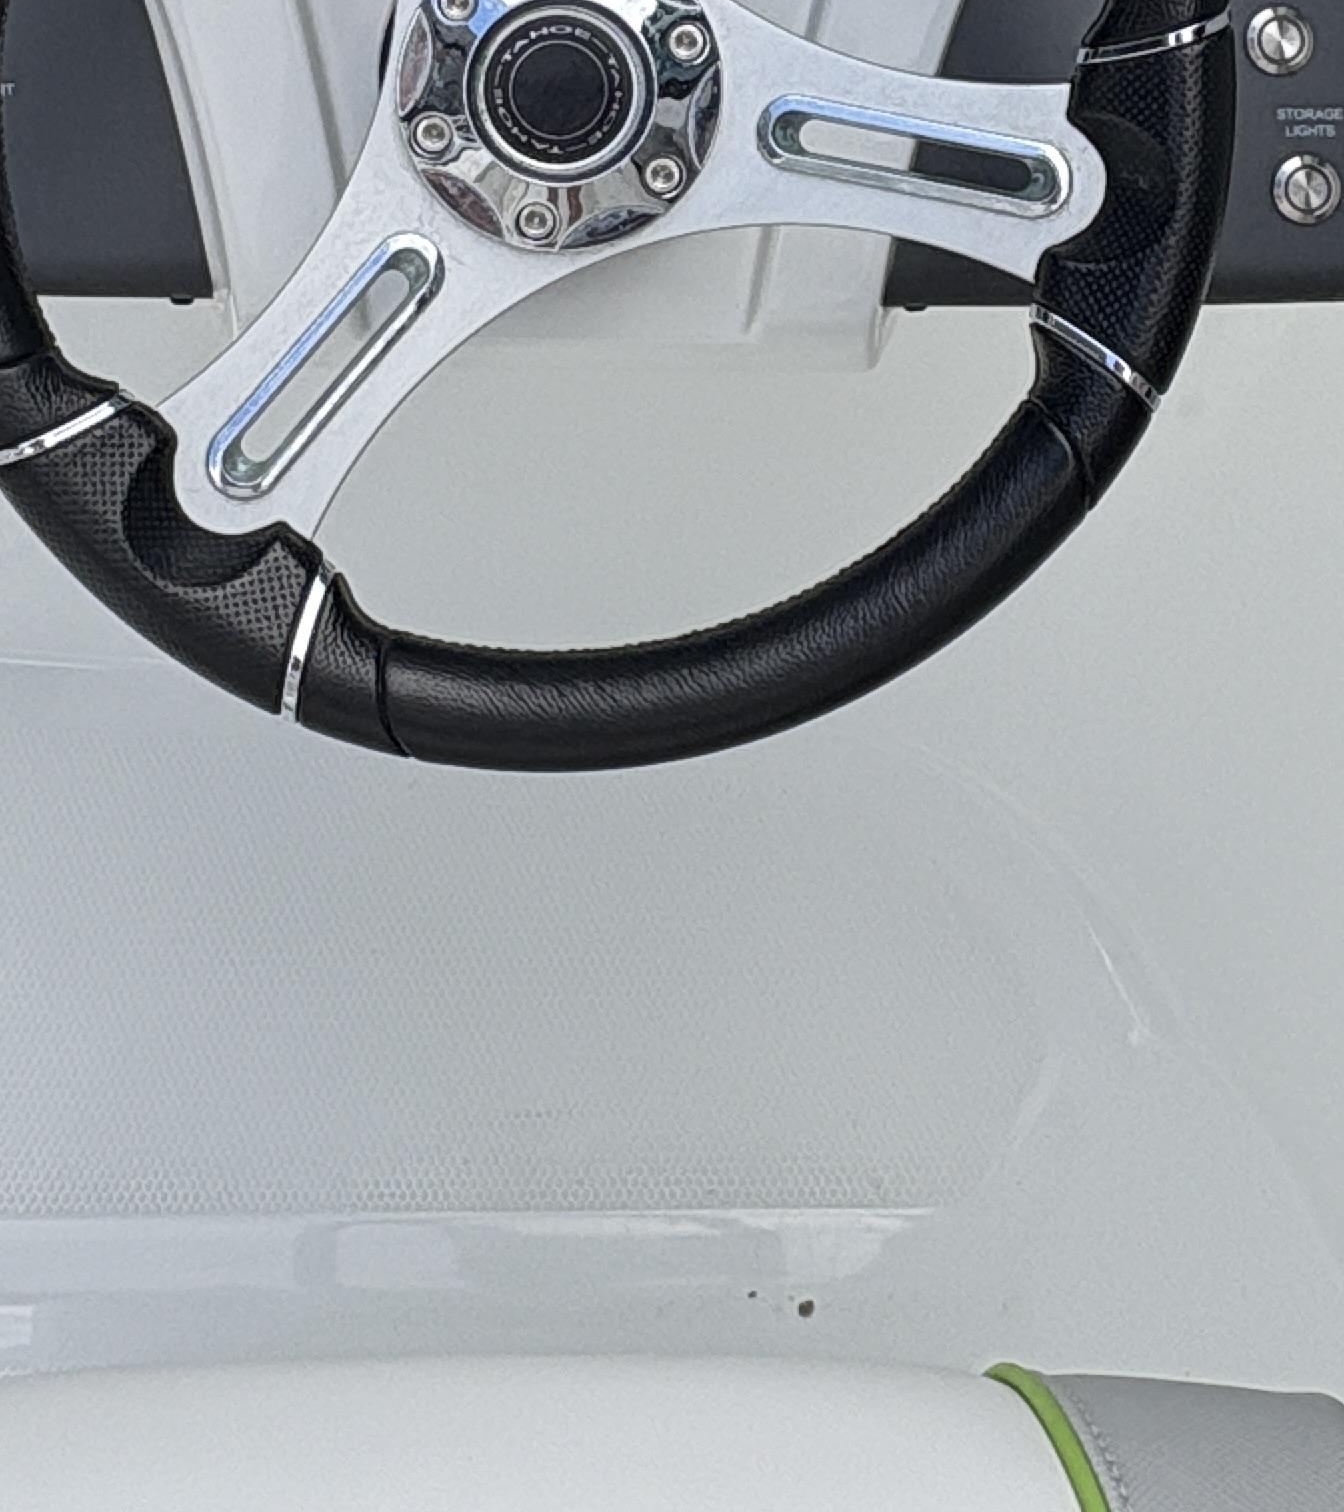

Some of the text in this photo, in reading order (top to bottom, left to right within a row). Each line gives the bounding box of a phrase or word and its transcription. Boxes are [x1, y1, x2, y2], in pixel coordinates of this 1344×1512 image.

[500, 24, 592, 64] TAHOE
[1276, 108, 1344, 121] STORAGE
[1284, 124, 1336, 138] LIGHTS
